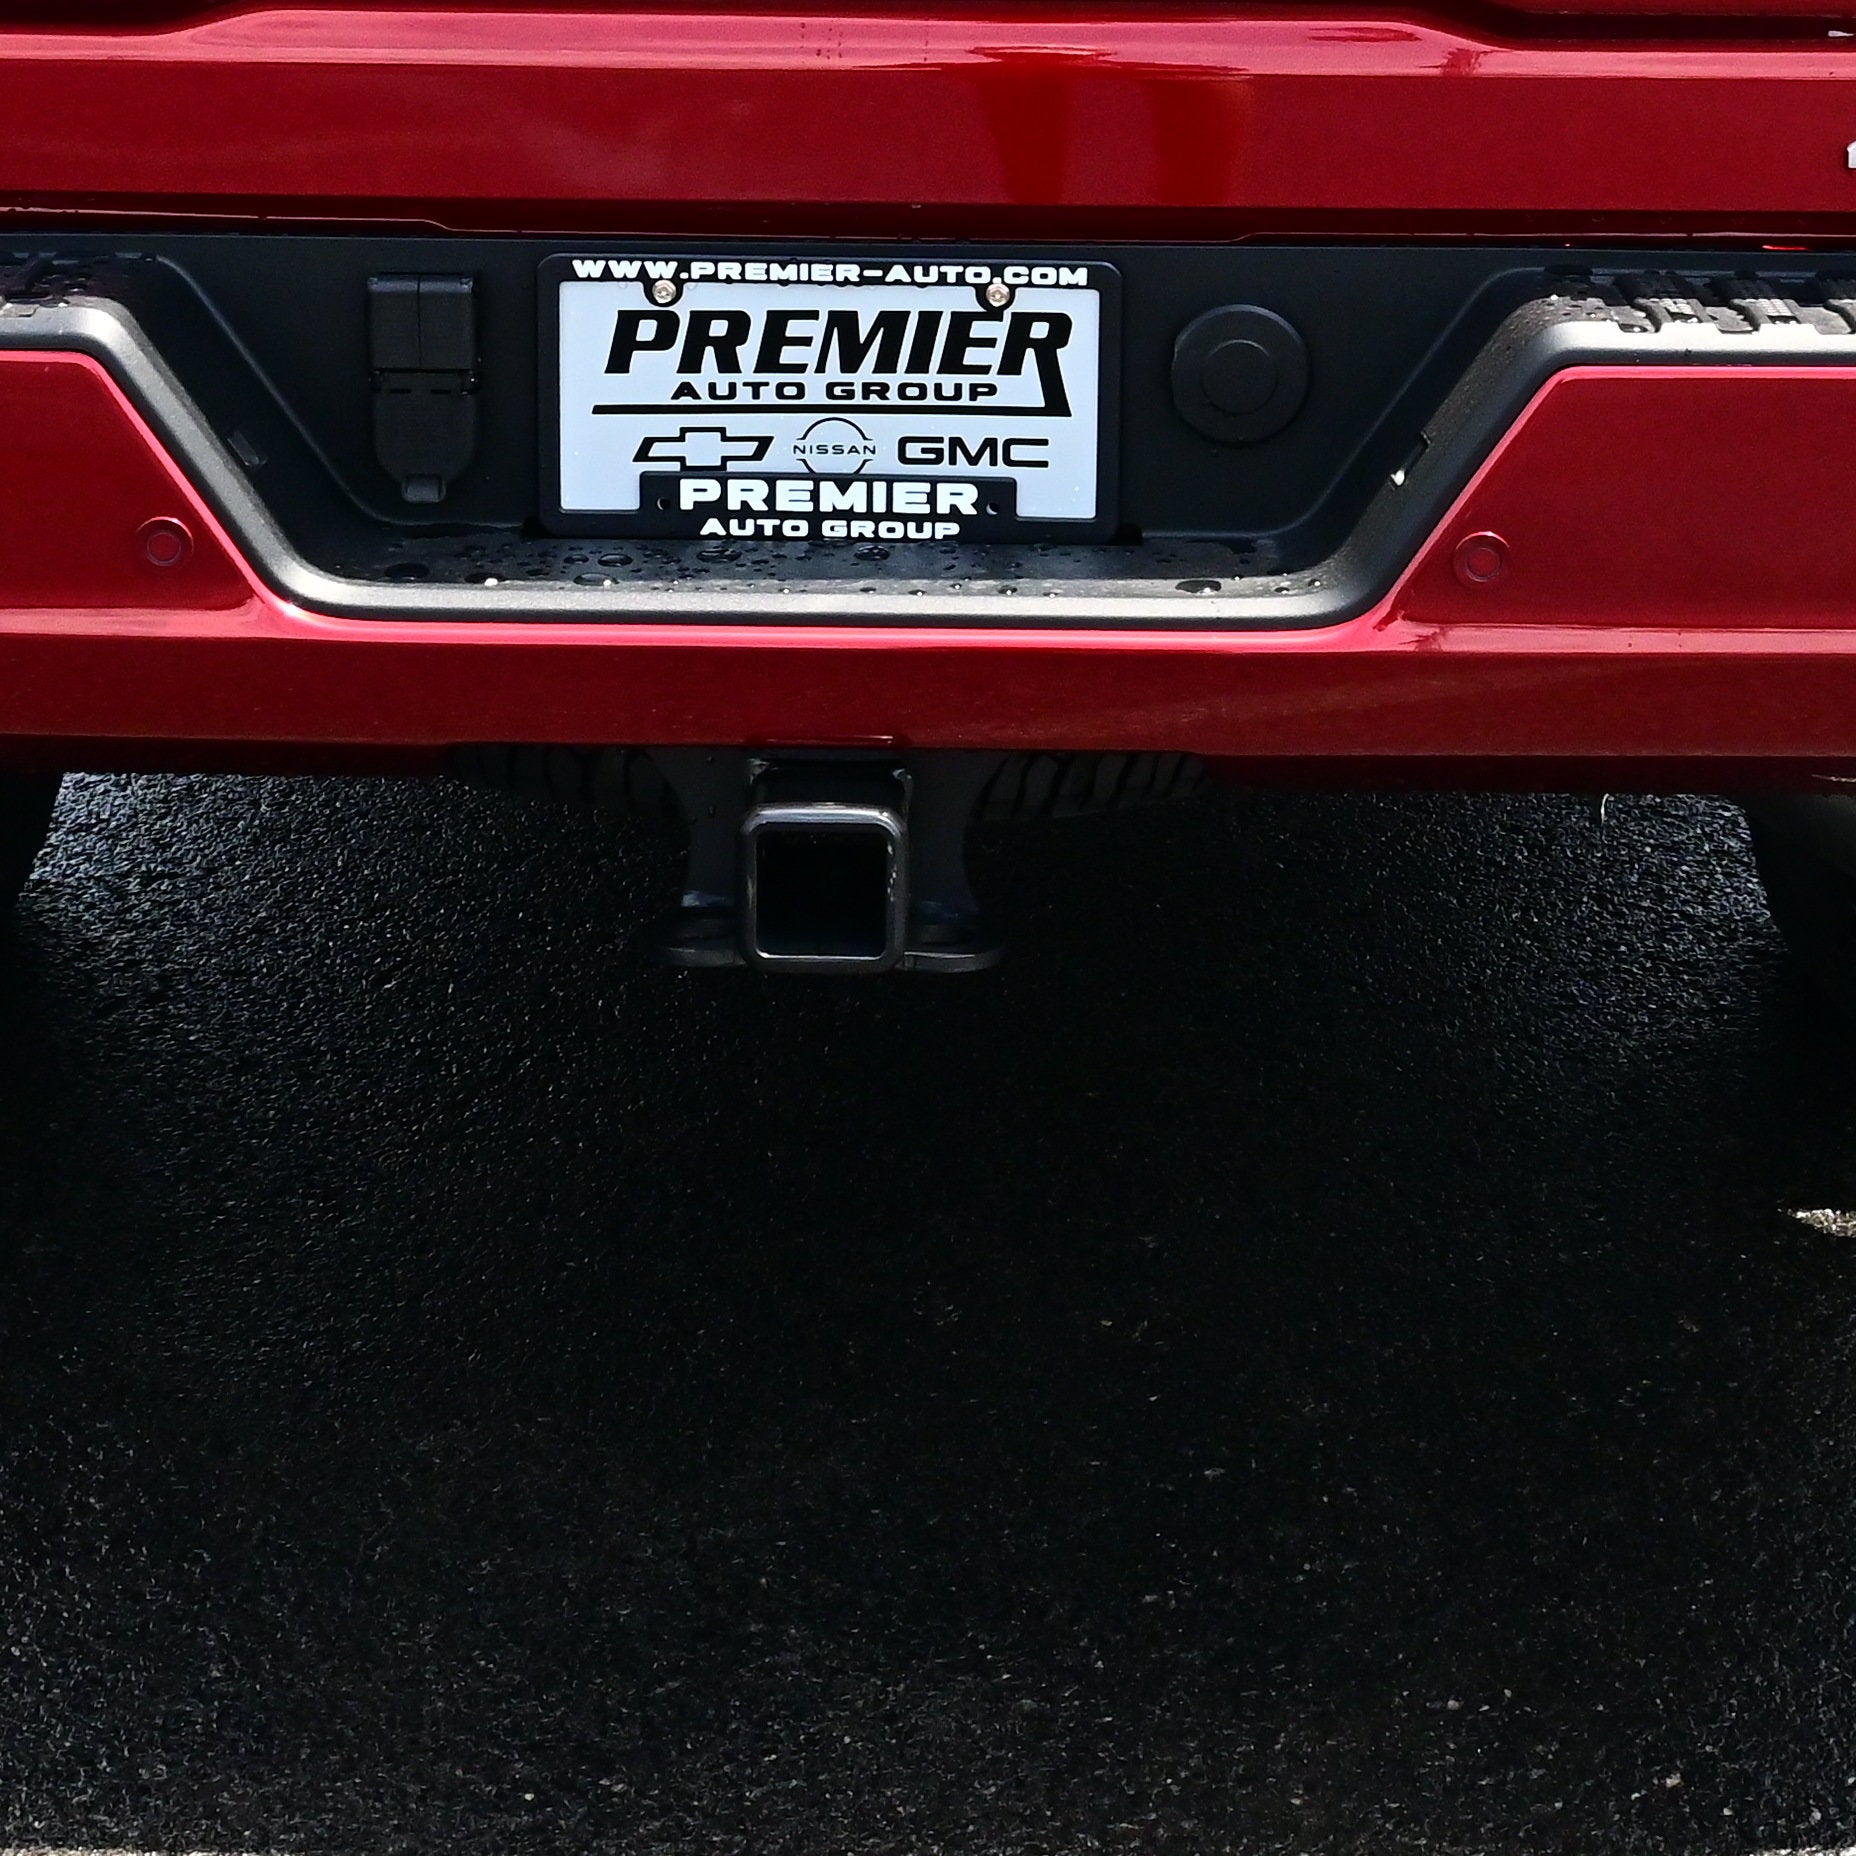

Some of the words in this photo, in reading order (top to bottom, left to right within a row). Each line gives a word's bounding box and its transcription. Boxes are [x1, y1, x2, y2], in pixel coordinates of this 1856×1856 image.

[572, 259, 1089, 286] WWW.PREMIER-AUTO.COM
[604, 309, 1074, 417] PREMIER
[670, 380, 807, 401] AUTO
[824, 381, 999, 402] GROUP
[792, 443, 876, 457] NISSAN
[897, 436, 1050, 468] GMC
[679, 478, 979, 516] PREMIER
[699, 518, 808, 539] AUTO
[820, 519, 961, 540] GROUP
